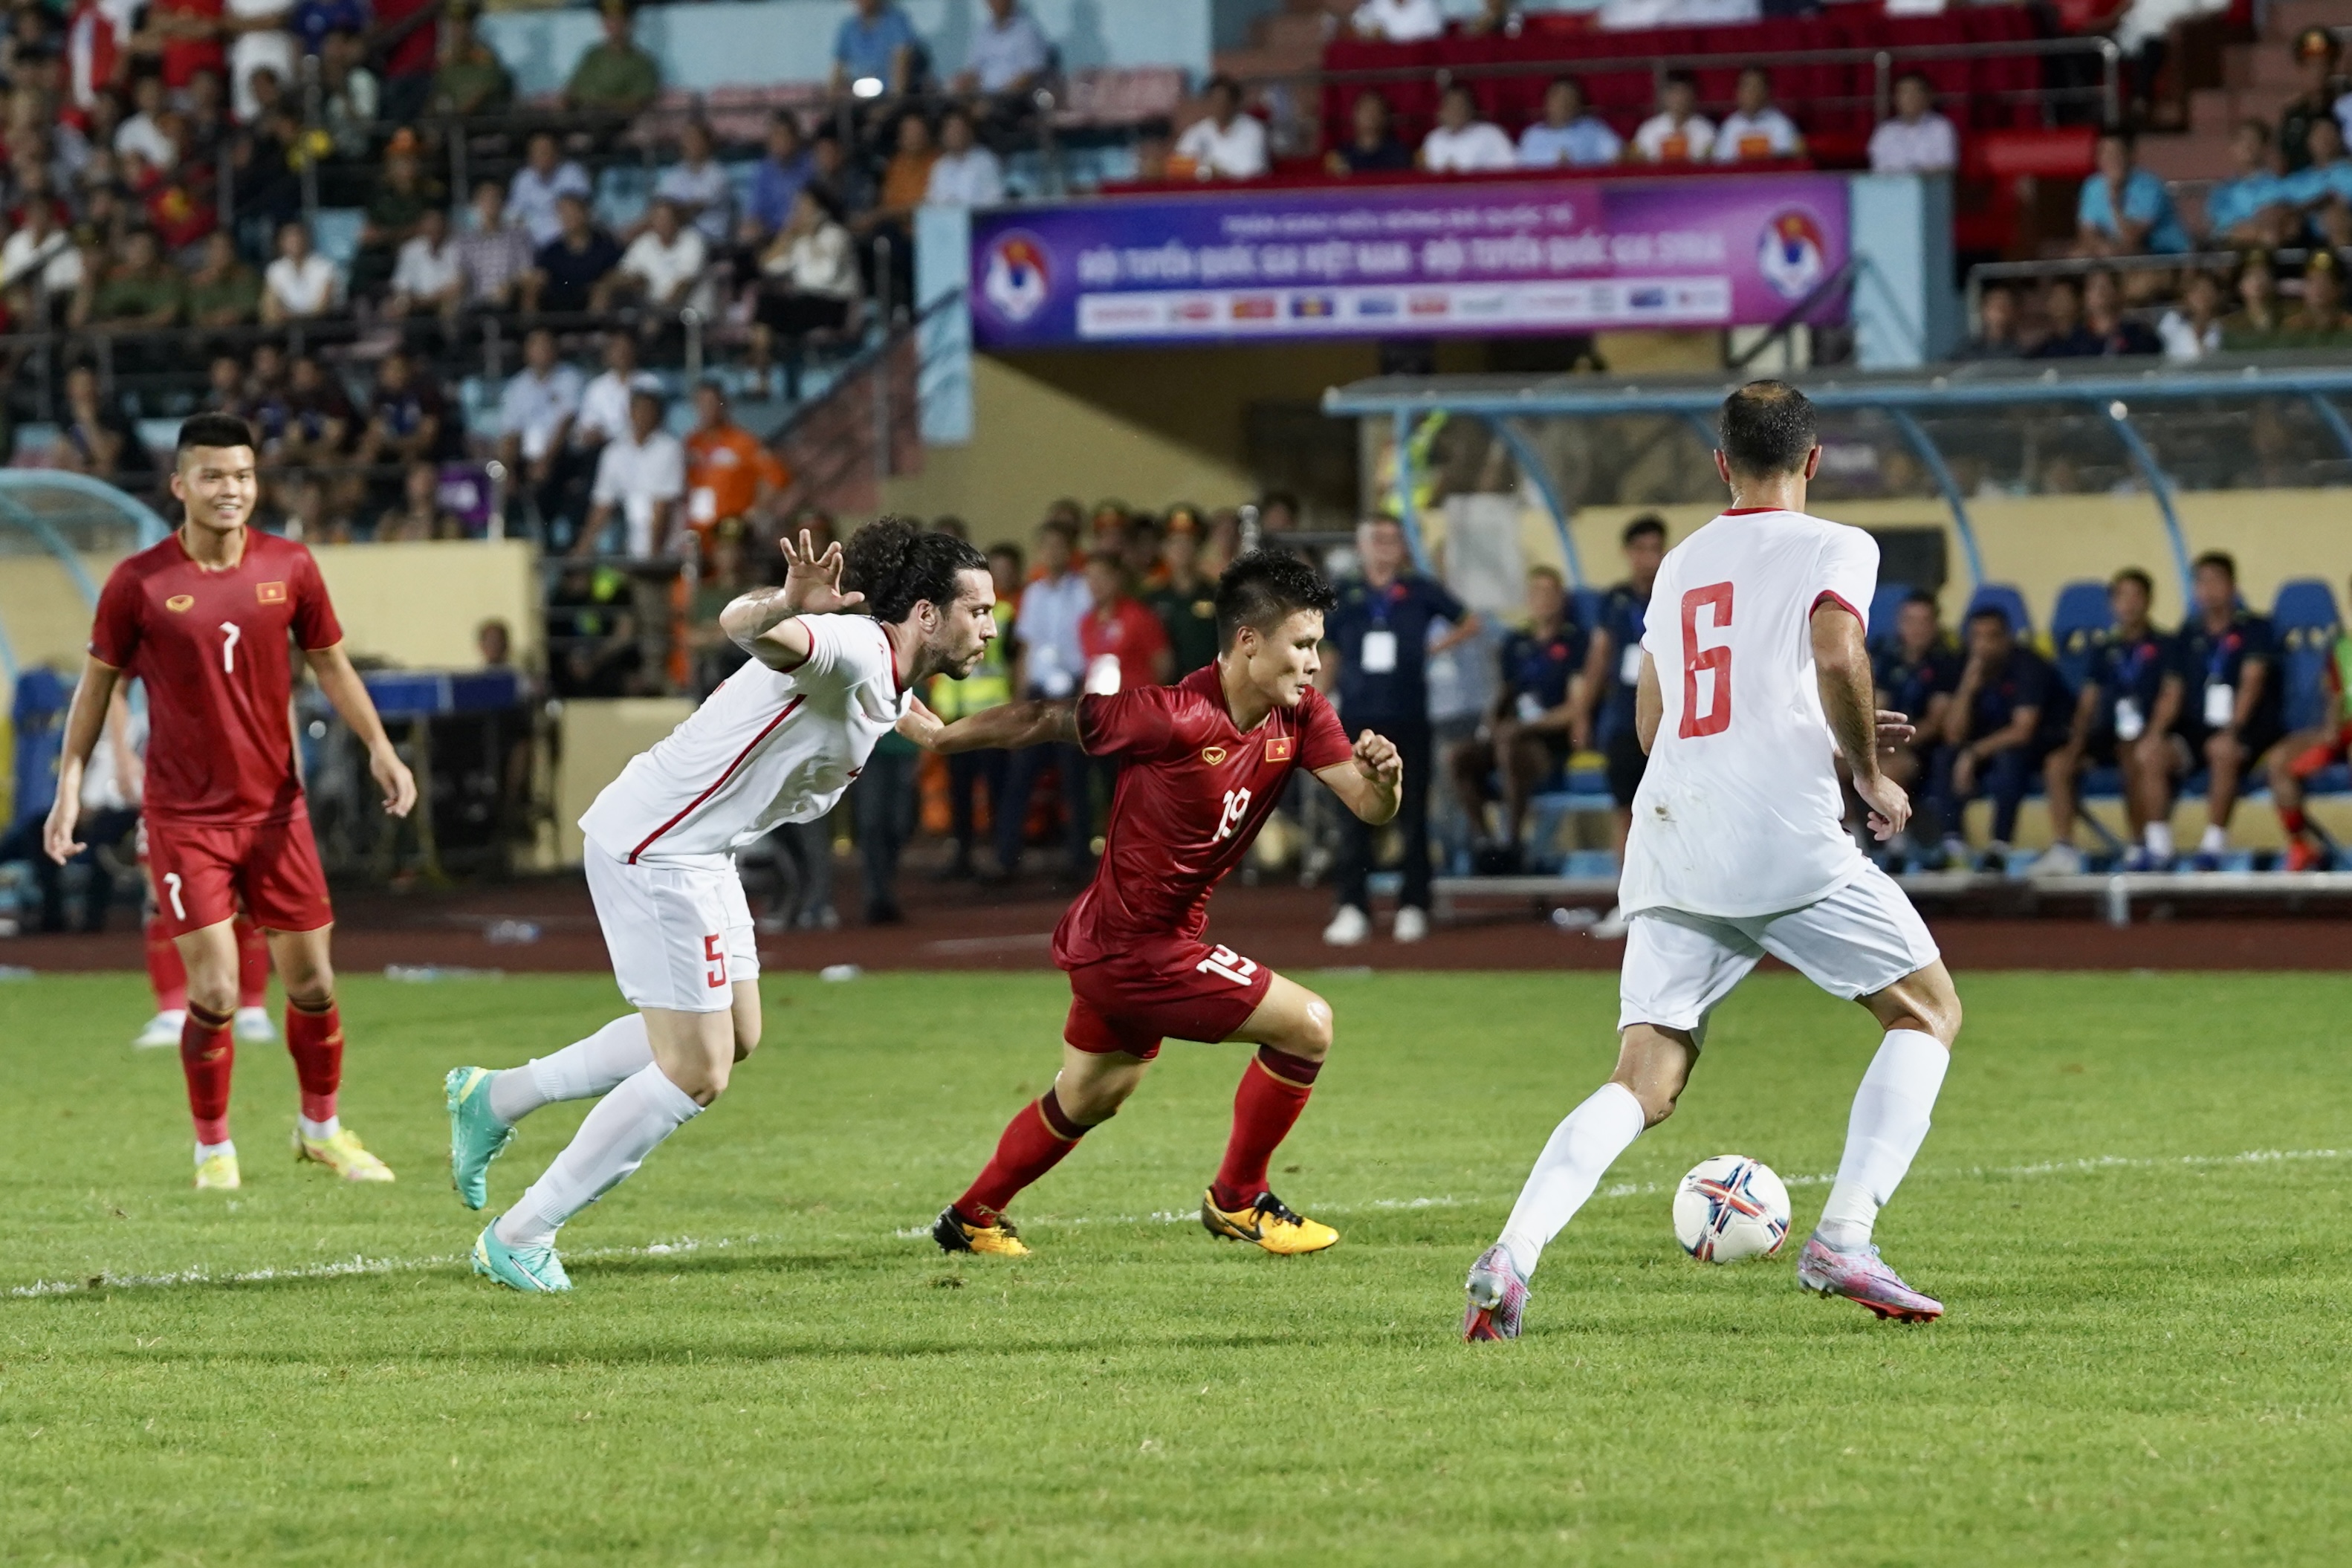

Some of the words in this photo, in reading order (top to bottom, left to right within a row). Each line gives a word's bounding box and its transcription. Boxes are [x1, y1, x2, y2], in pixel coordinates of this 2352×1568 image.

[219, 621, 240, 673] 7
[1679, 581, 1734, 739] 6
[1211, 787, 1252, 842] 19
[163, 872, 185, 921] 7
[704, 933, 727, 988] 5
[1196, 944, 1257, 986] 19
